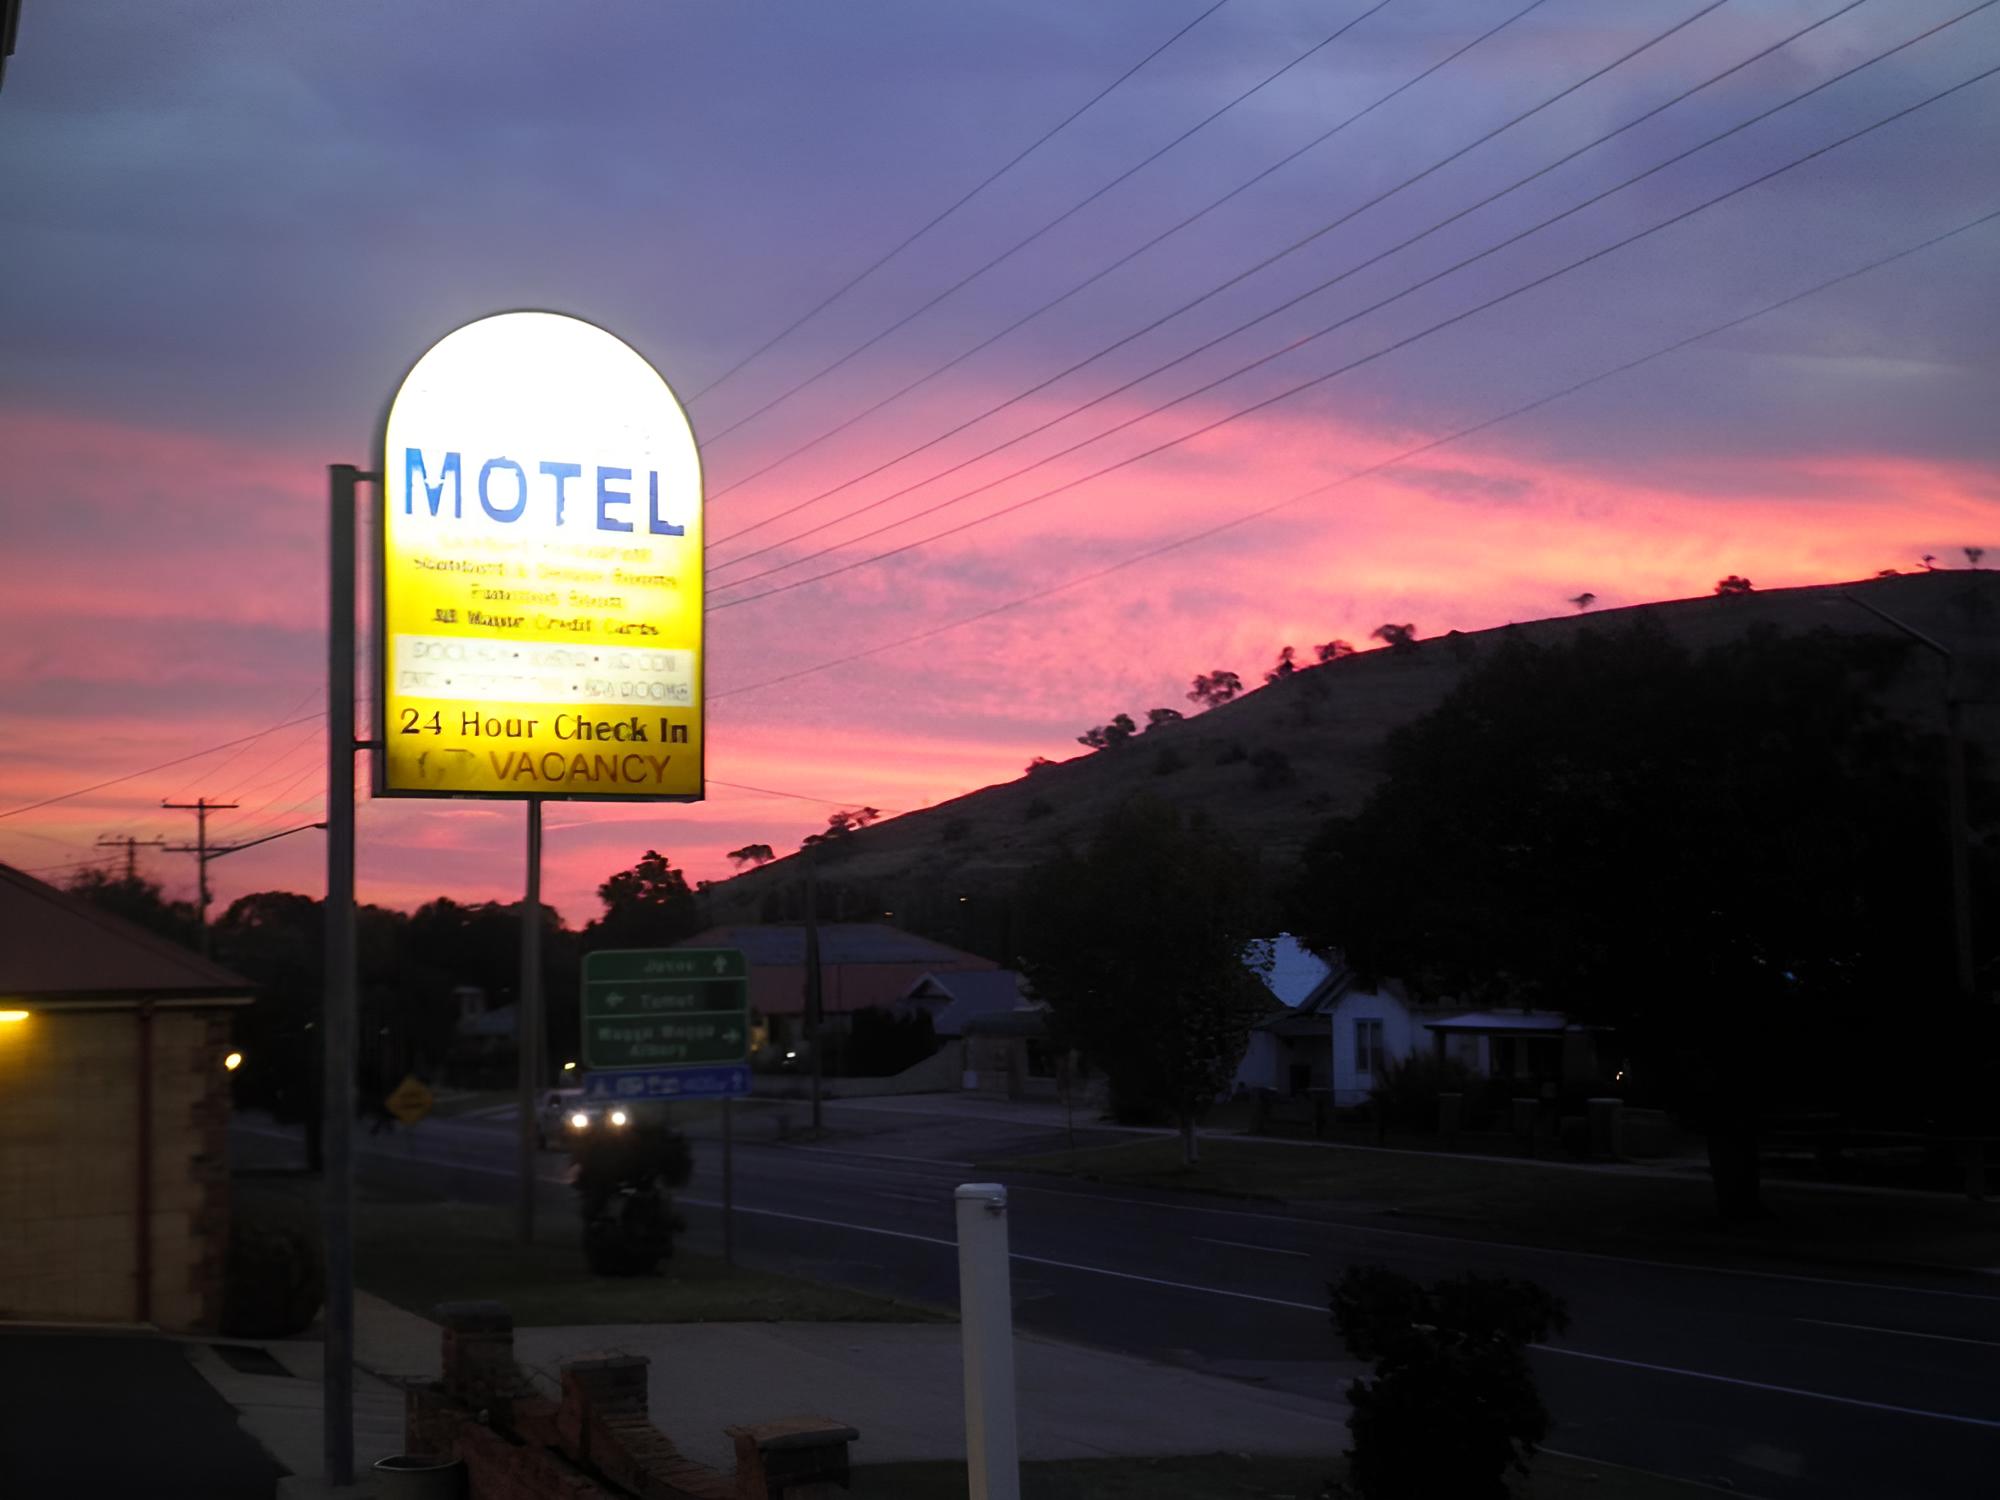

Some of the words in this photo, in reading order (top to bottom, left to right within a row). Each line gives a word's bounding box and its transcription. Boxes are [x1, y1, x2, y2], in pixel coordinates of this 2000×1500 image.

[405, 448, 684, 536] MOTEL
[400, 708, 441, 735] 24
[461, 711, 538, 738] Hour
[554, 714, 647, 742] Check
[660, 718, 688, 743] In
[489, 751, 671, 784] VACANCY
